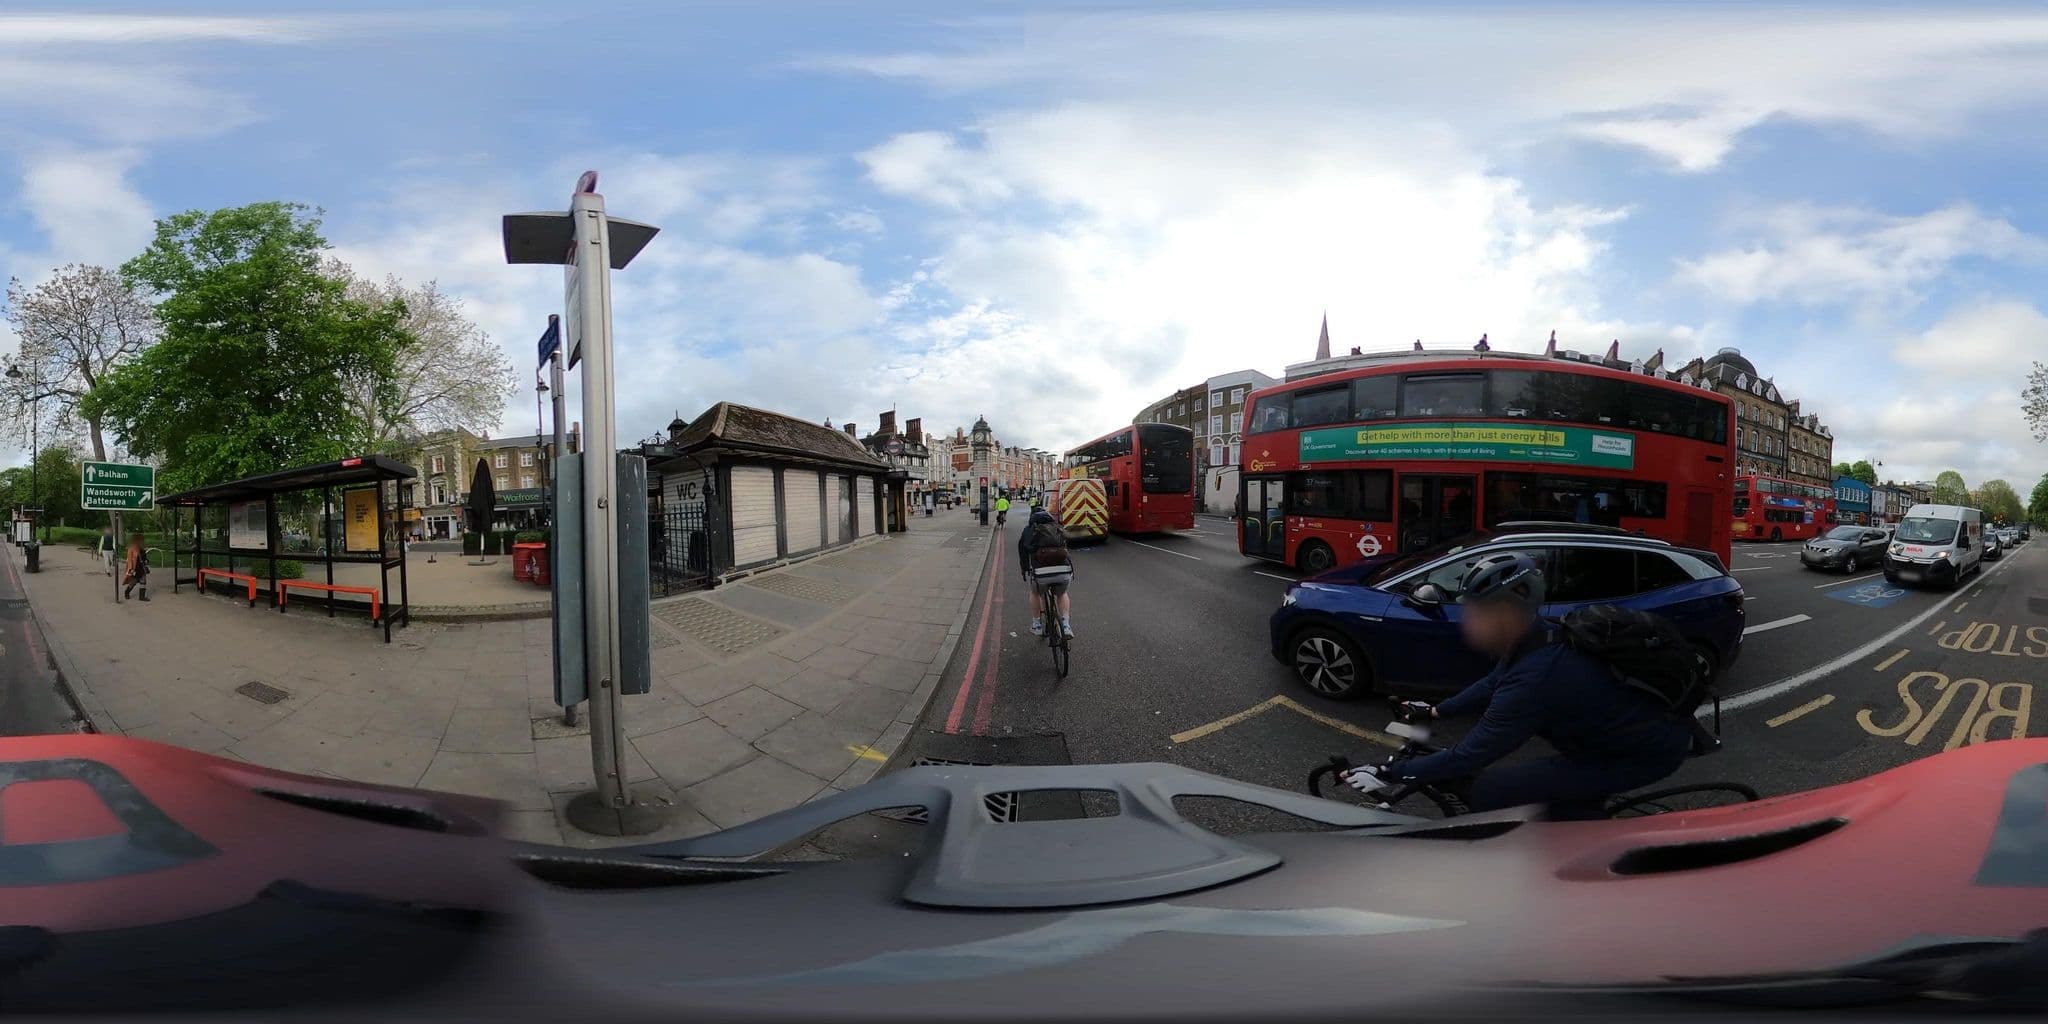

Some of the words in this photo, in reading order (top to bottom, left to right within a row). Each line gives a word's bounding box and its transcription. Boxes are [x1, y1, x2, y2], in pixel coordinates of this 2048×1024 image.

[1361, 432, 1378, 440] Get
[1380, 432, 1399, 440] help
[1401, 430, 1422, 439] with
[1424, 431, 1450, 439] more
[1453, 430, 1475, 439] than
[1477, 431, 1497, 440] just
[1500, 432, 1536, 442] energy
[1538, 432, 1560, 442] bills
[1420, 447, 1433, 455] help
[98, 469, 128, 479] Balham
[86, 487, 136, 497] Wandsworth
[676, 482, 697, 500] WC
[86, 497, 126, 505] Battersea
[1937, 621, 2048, 657] STOP
[1856, 671, 2033, 752] BUS
